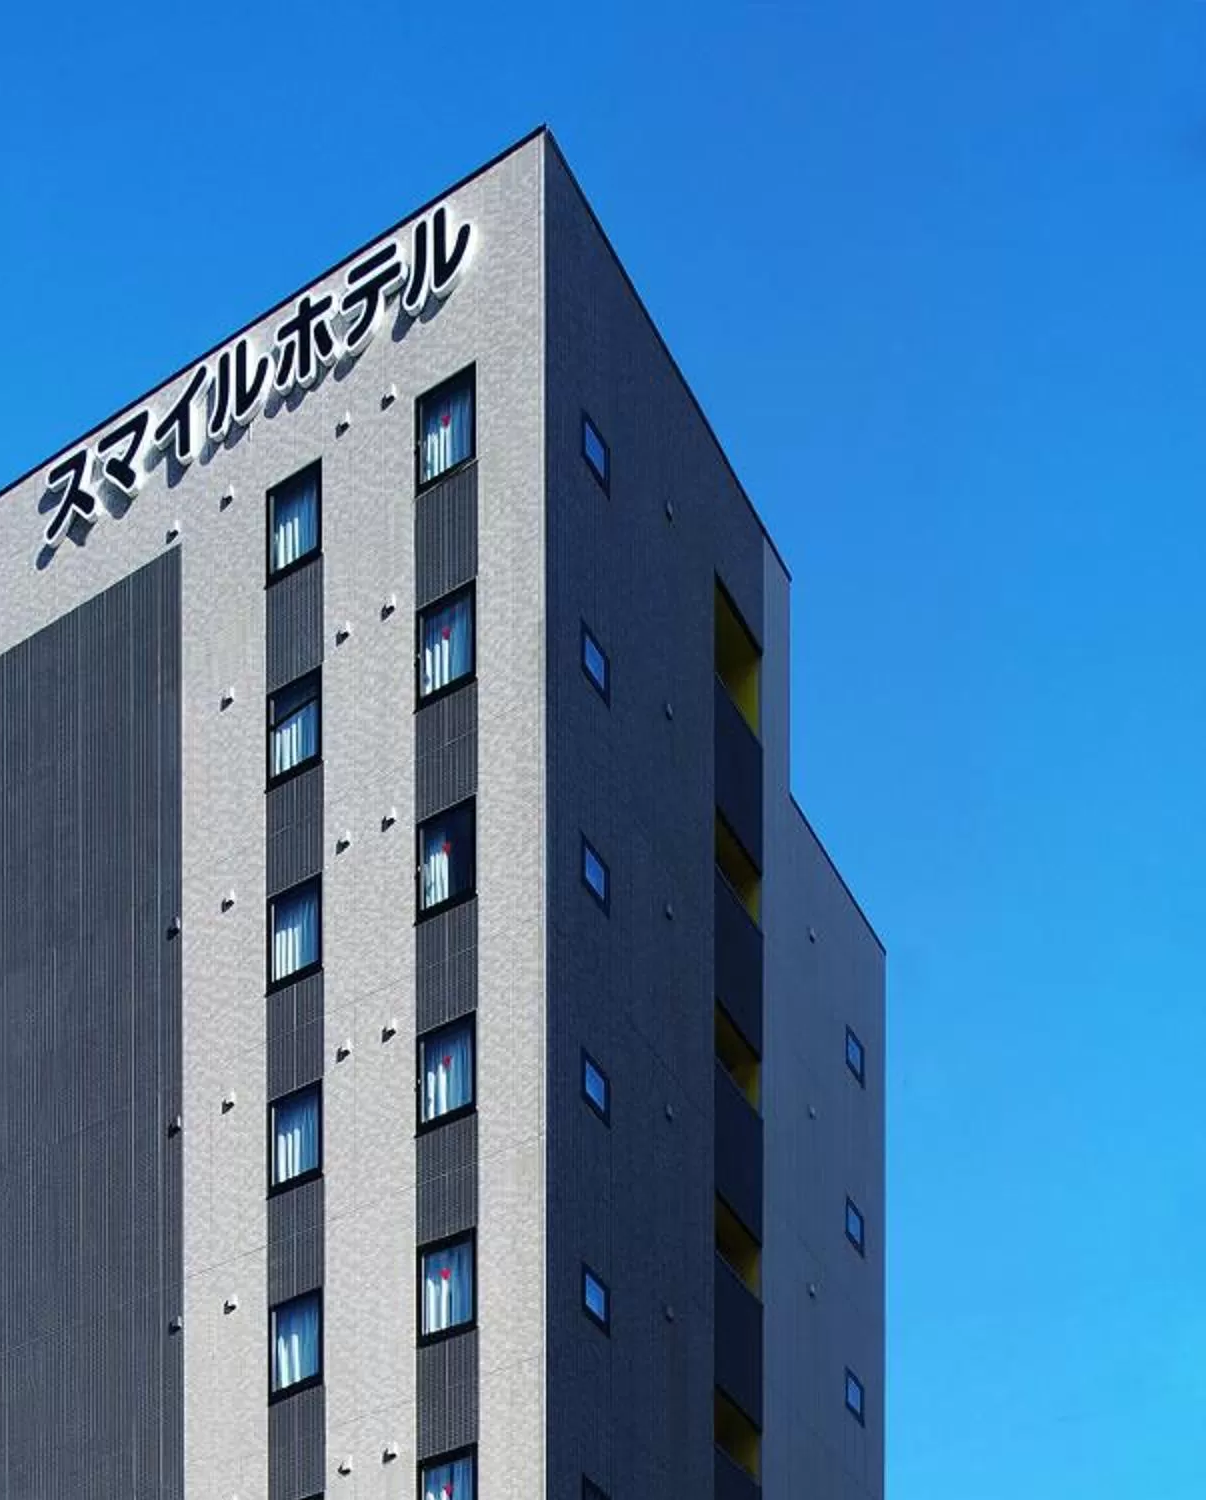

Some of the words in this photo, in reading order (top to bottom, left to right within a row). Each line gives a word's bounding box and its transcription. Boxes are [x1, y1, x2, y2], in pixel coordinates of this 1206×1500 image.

[44, 206, 472, 541] スマイルホテル
